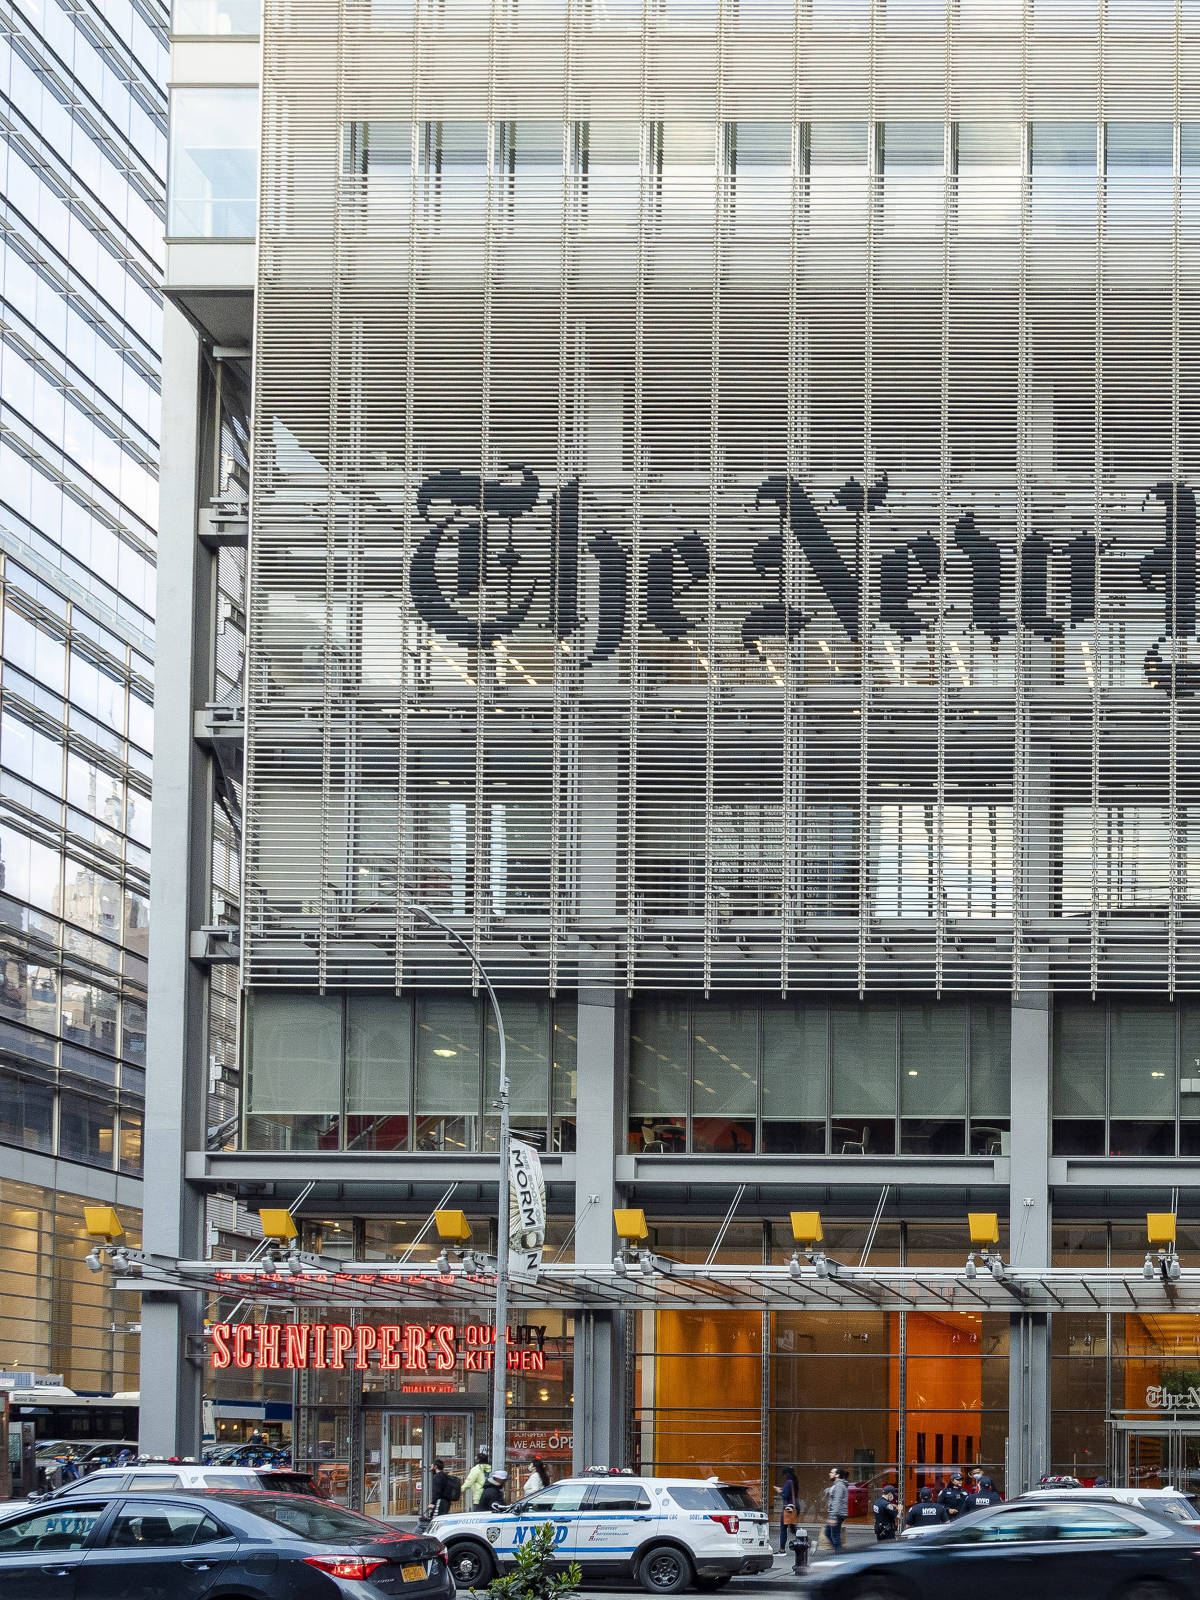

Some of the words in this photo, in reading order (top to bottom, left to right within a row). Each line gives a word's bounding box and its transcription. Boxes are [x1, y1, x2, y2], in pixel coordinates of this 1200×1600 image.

[409, 463, 709, 668] The
[741, 471, 1117, 660] New
[211, 1323, 456, 1370] SCHNIPPER'S
[465, 1350, 545, 1370] KITHEN
[1146, 1385, 1184, 1410] The
[513, 1441, 528, 1449] WE
[529, 1440, 547, 1449] ARE
[548, 1436, 574, 1449] OPE
[512, 1526, 568, 1544] NYD
